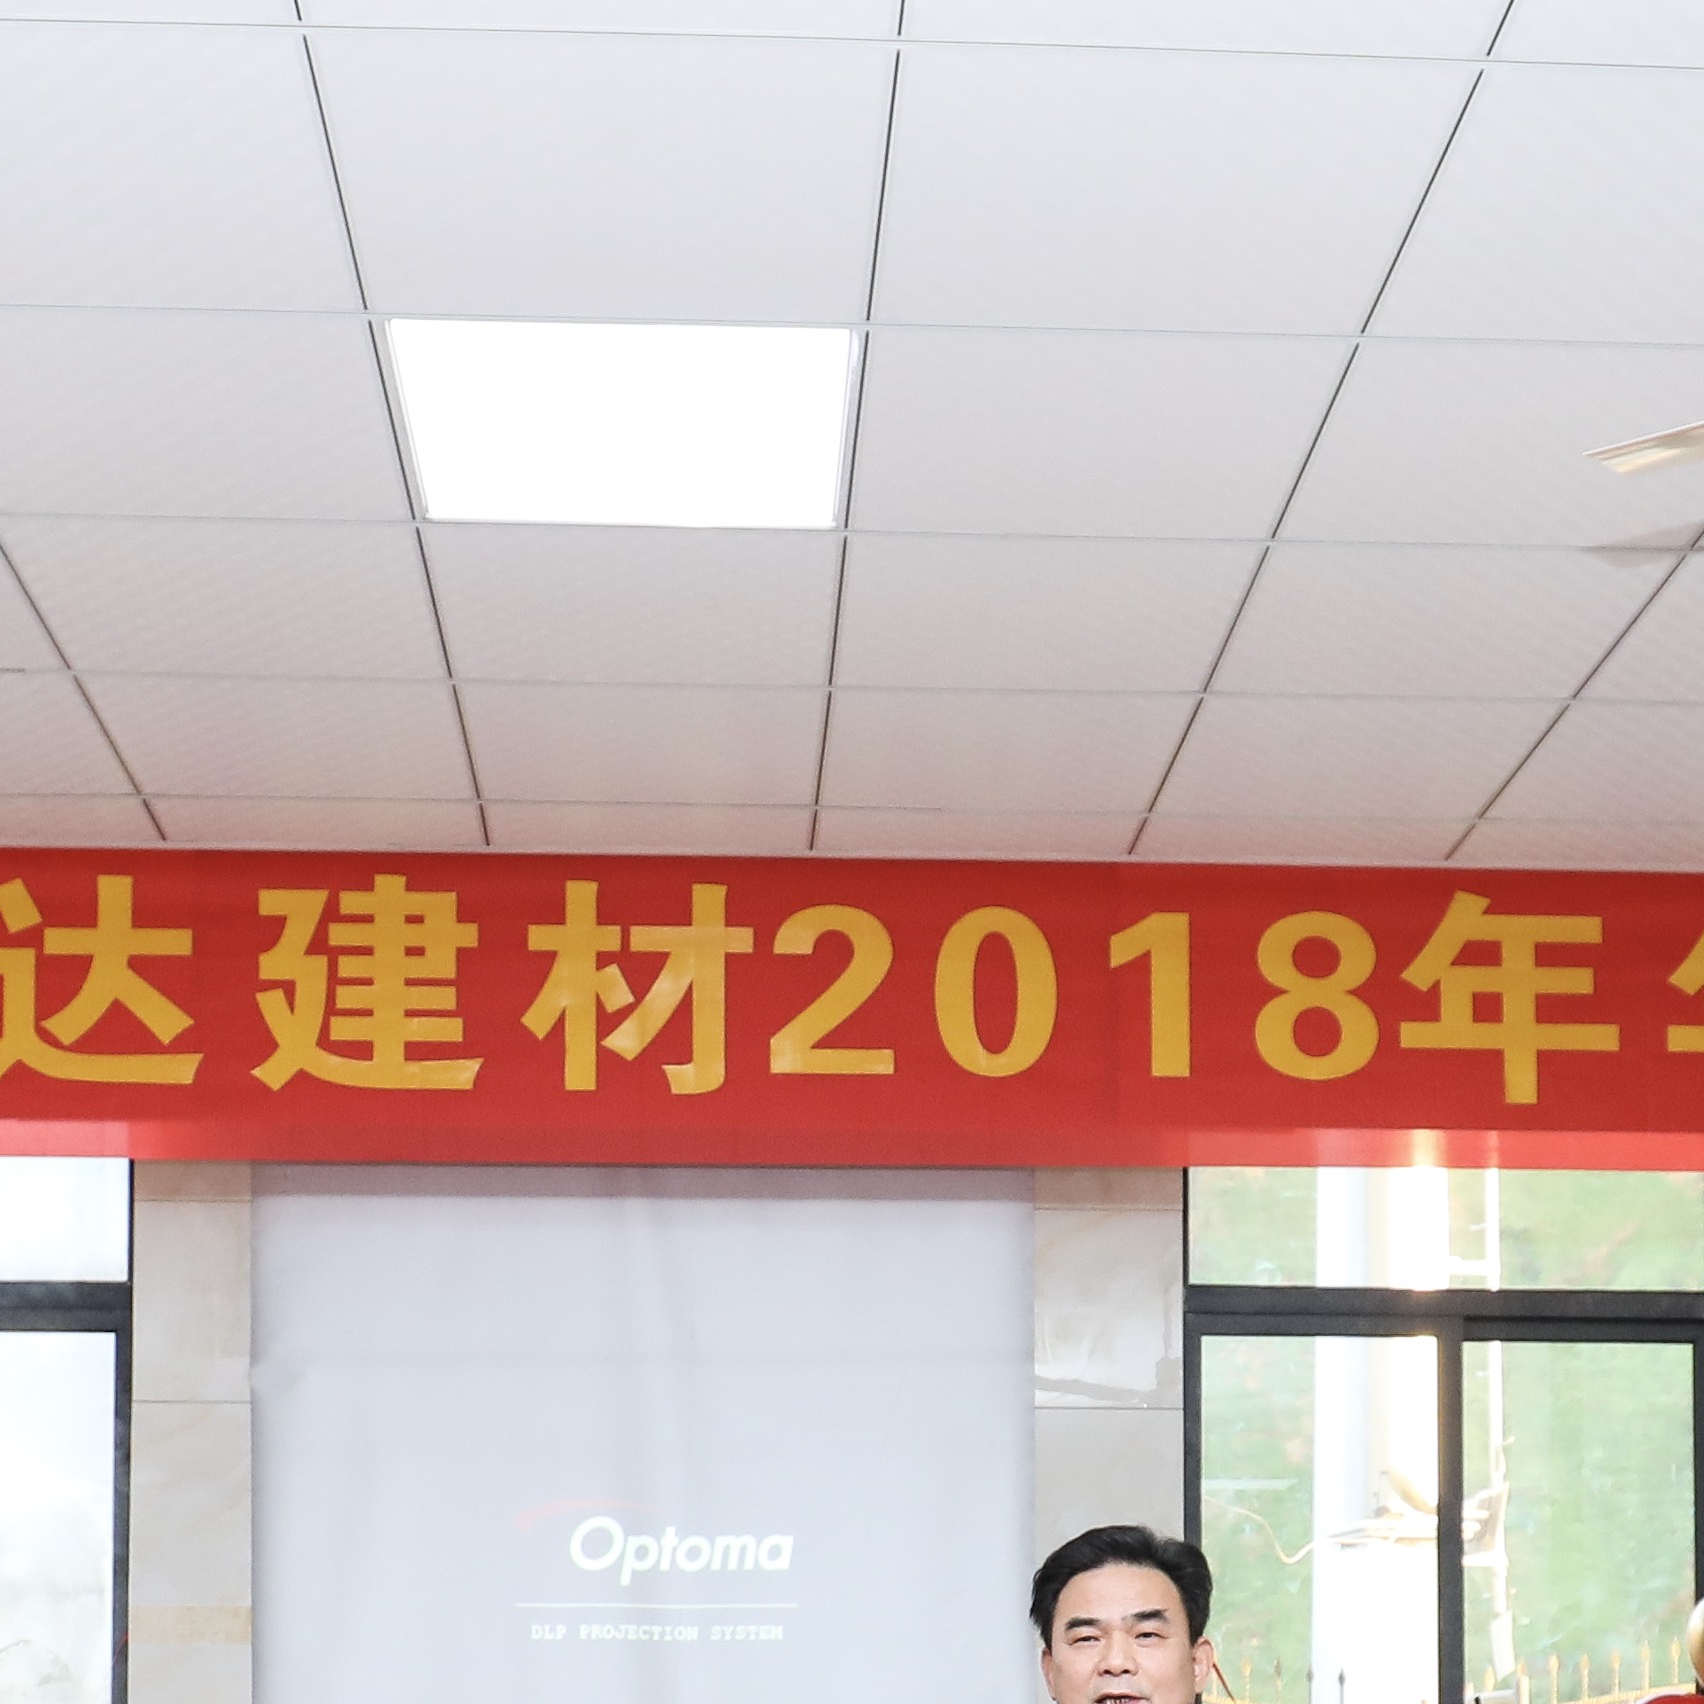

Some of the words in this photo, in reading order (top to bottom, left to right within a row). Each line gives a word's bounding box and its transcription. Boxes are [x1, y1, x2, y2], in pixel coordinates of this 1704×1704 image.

[570, 1516, 794, 1586] Optoma
[530, 1624, 568, 1641] DLP
[579, 1624, 699, 1642] PROJECTION
[710, 1625, 784, 1642] SYSTEM
